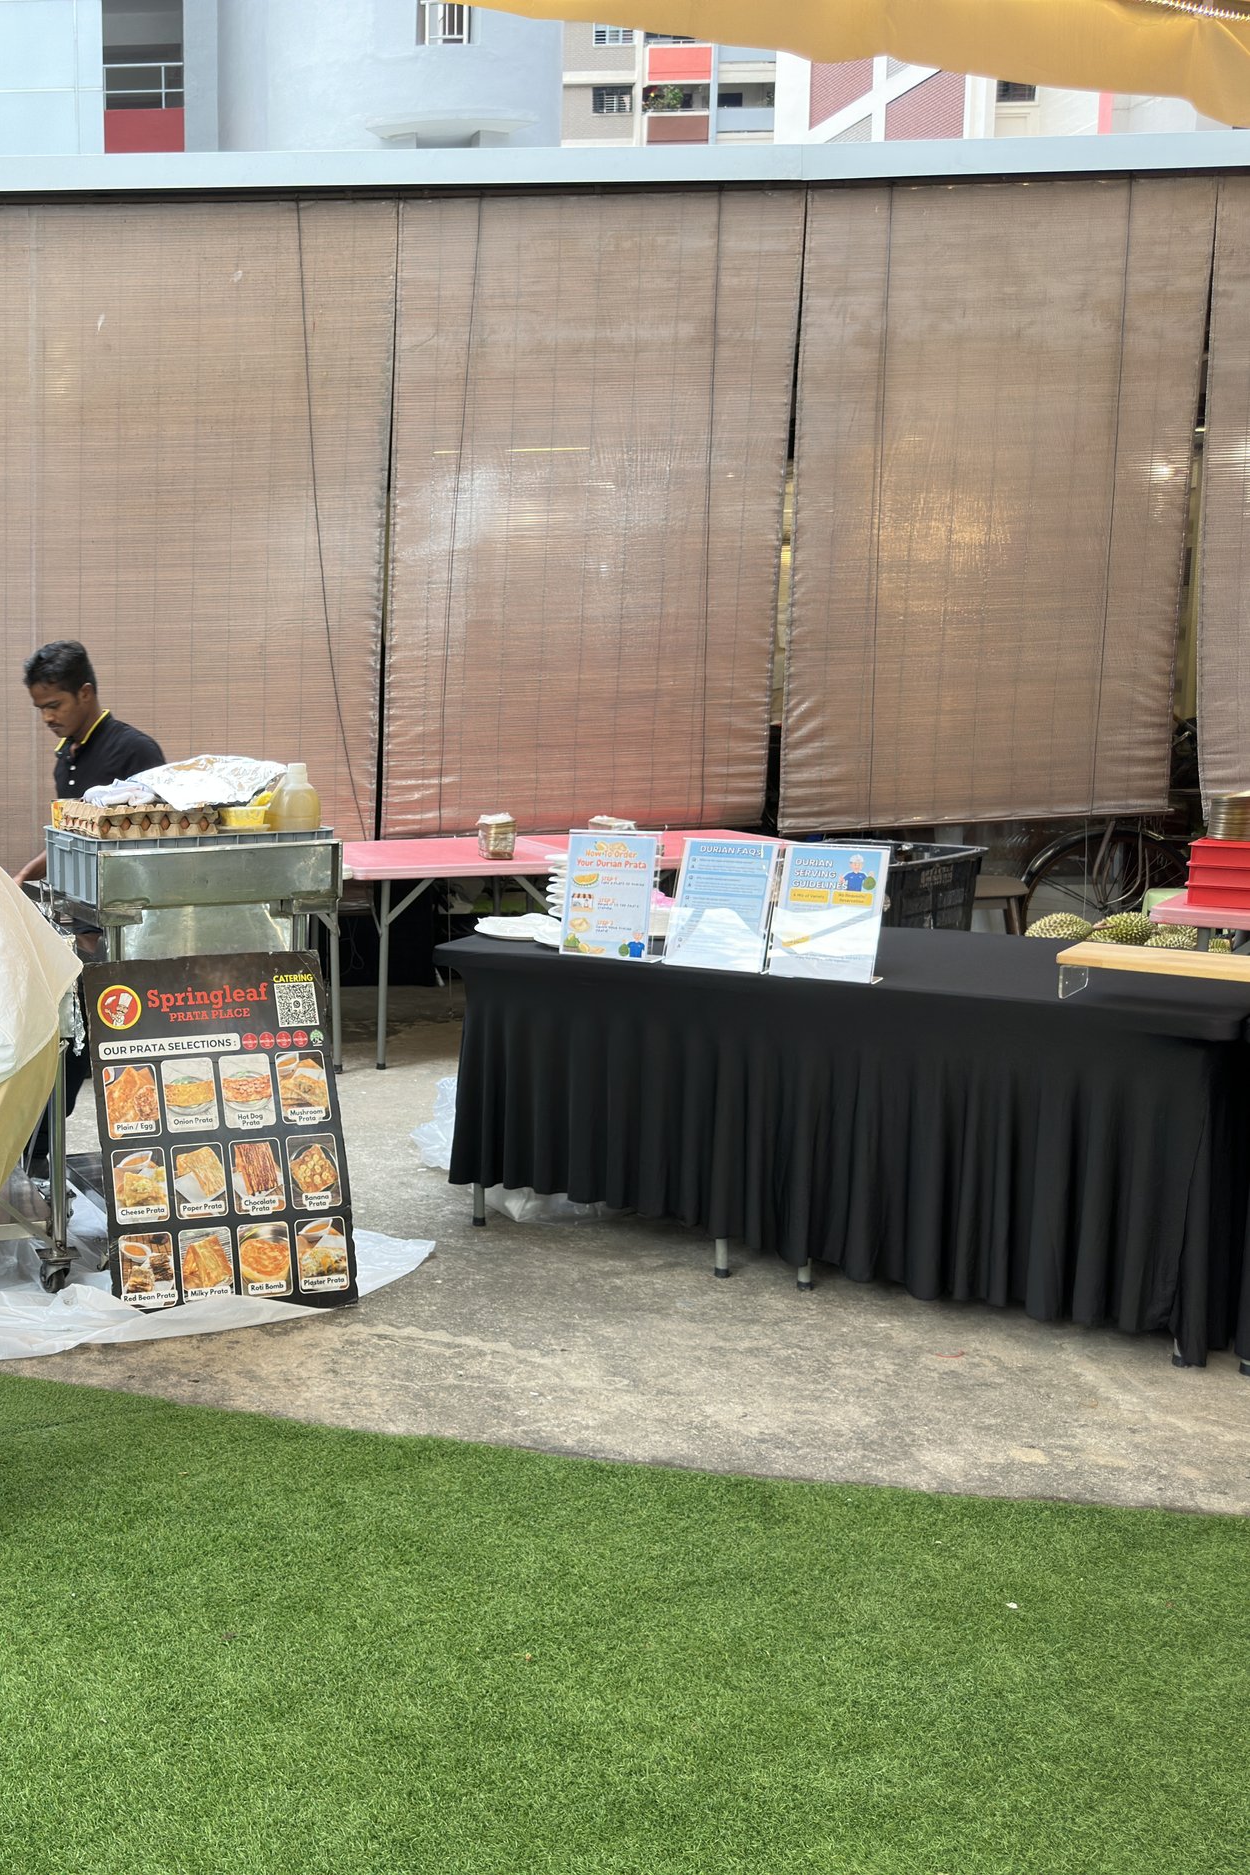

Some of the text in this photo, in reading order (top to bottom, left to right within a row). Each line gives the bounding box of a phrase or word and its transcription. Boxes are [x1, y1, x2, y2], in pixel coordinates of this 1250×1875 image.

[614, 850, 637, 858] Order
[700, 845, 735, 854] DURIAN
[577, 858, 646, 869] Your Durian Prata
[795, 858, 833, 867] DURIAN
[794, 869, 836, 878] SERVING
[792, 880, 848, 890] GUIDELINES
[273, 974, 313, 983] CATERING
[146, 982, 269, 1012] Springleaf
[169, 1008, 250, 1023] PRATA PLACE
[104, 1046, 127, 1056] OUR
[130, 1044, 165, 1054] PRATA
[168, 1038, 232, 1051] SELECTIONS
[265, 1282, 284, 1290] Bomb
[123, 1294, 137, 1302] Red
